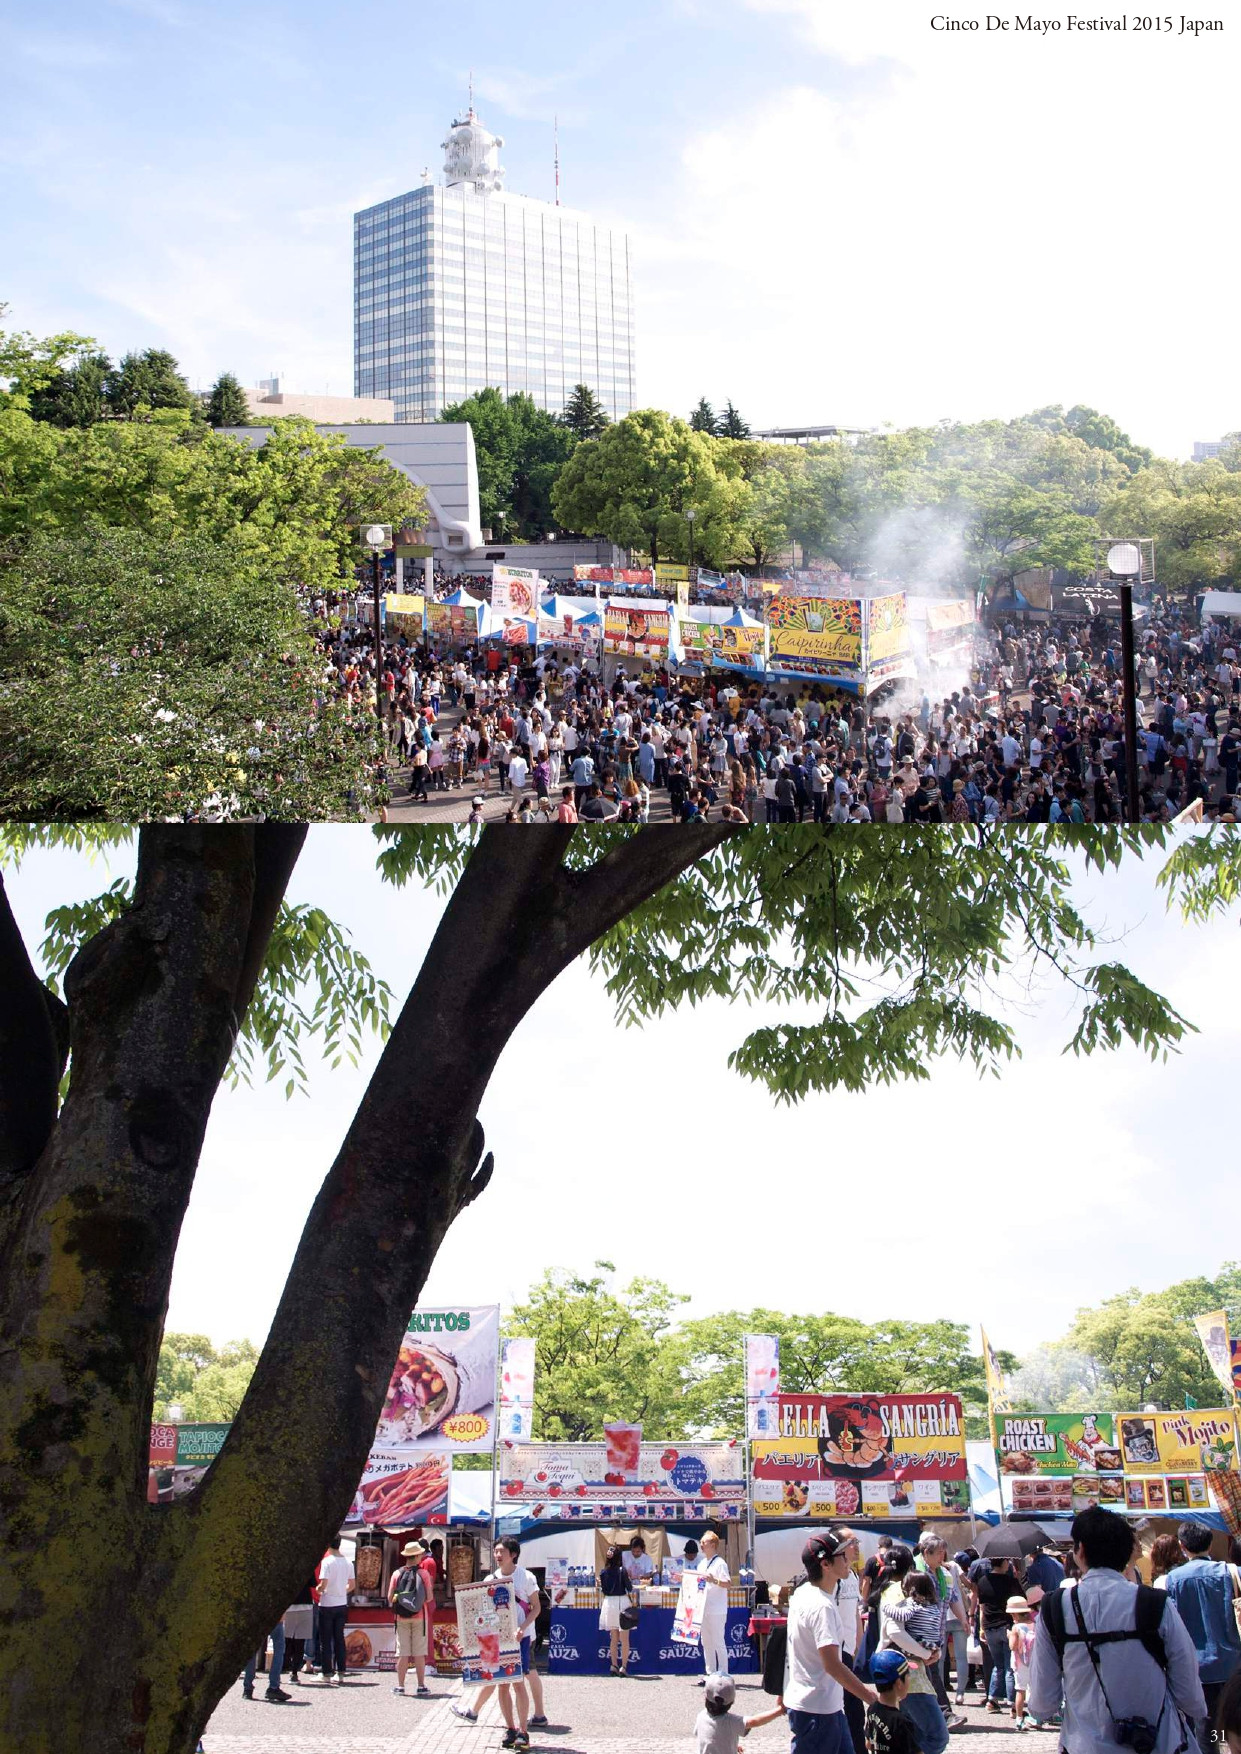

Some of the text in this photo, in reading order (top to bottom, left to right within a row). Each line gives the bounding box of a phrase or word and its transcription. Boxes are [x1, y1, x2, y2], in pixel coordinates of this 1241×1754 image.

[776, 631, 853, 654] Caipirinha
[408, 1311, 470, 1332] RITOS
[449, 1420, 482, 1433] ¥800
[780, 1399, 960, 1438] ELLA SANGRÍA
[1161, 1416, 1190, 1434] Pink
[150, 1427, 175, 1438] OCA
[1004, 1419, 1045, 1435] ROAST
[1176, 1420, 1230, 1446] Mojito
[150, 1438, 174, 1449] NGE
[1000, 1435, 1056, 1452] CHICKEN
[761, 1450, 960, 1468] パエリア サングリア
[548, 1648, 579, 1660] AUZA
[659, 1647, 701, 1660] SAUZA
[727, 1646, 754, 1658] AUZ
